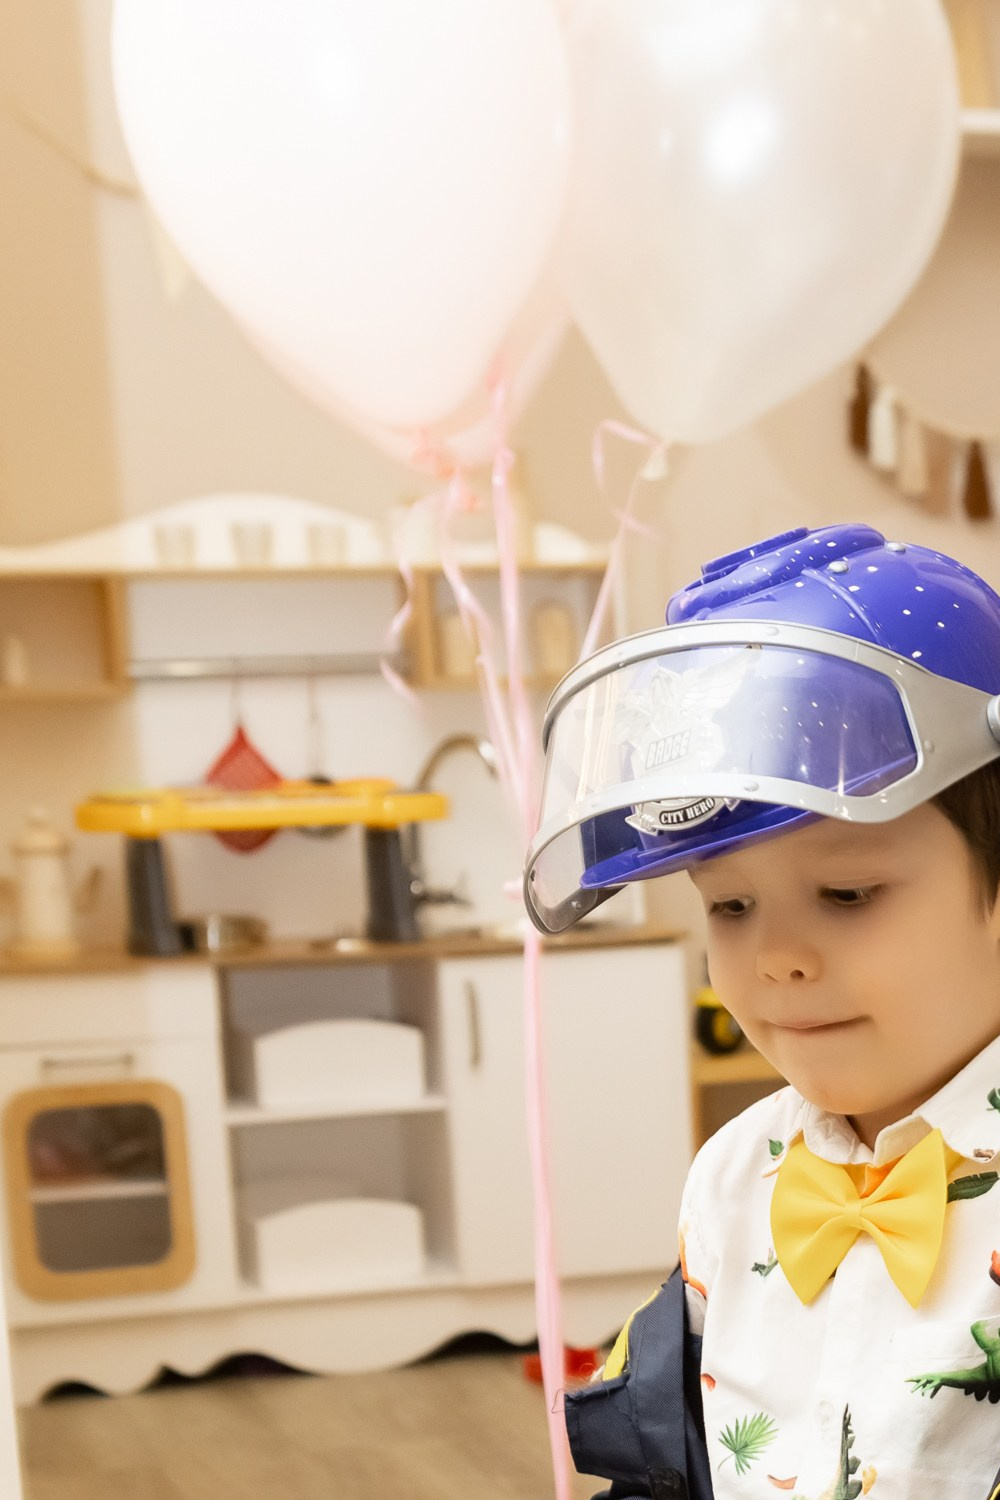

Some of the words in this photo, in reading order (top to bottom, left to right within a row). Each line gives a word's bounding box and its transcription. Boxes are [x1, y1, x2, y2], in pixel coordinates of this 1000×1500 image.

[647, 730, 691, 769] BADGE
[660, 809, 684, 825] CITY
[686, 797, 715, 820] HERO
